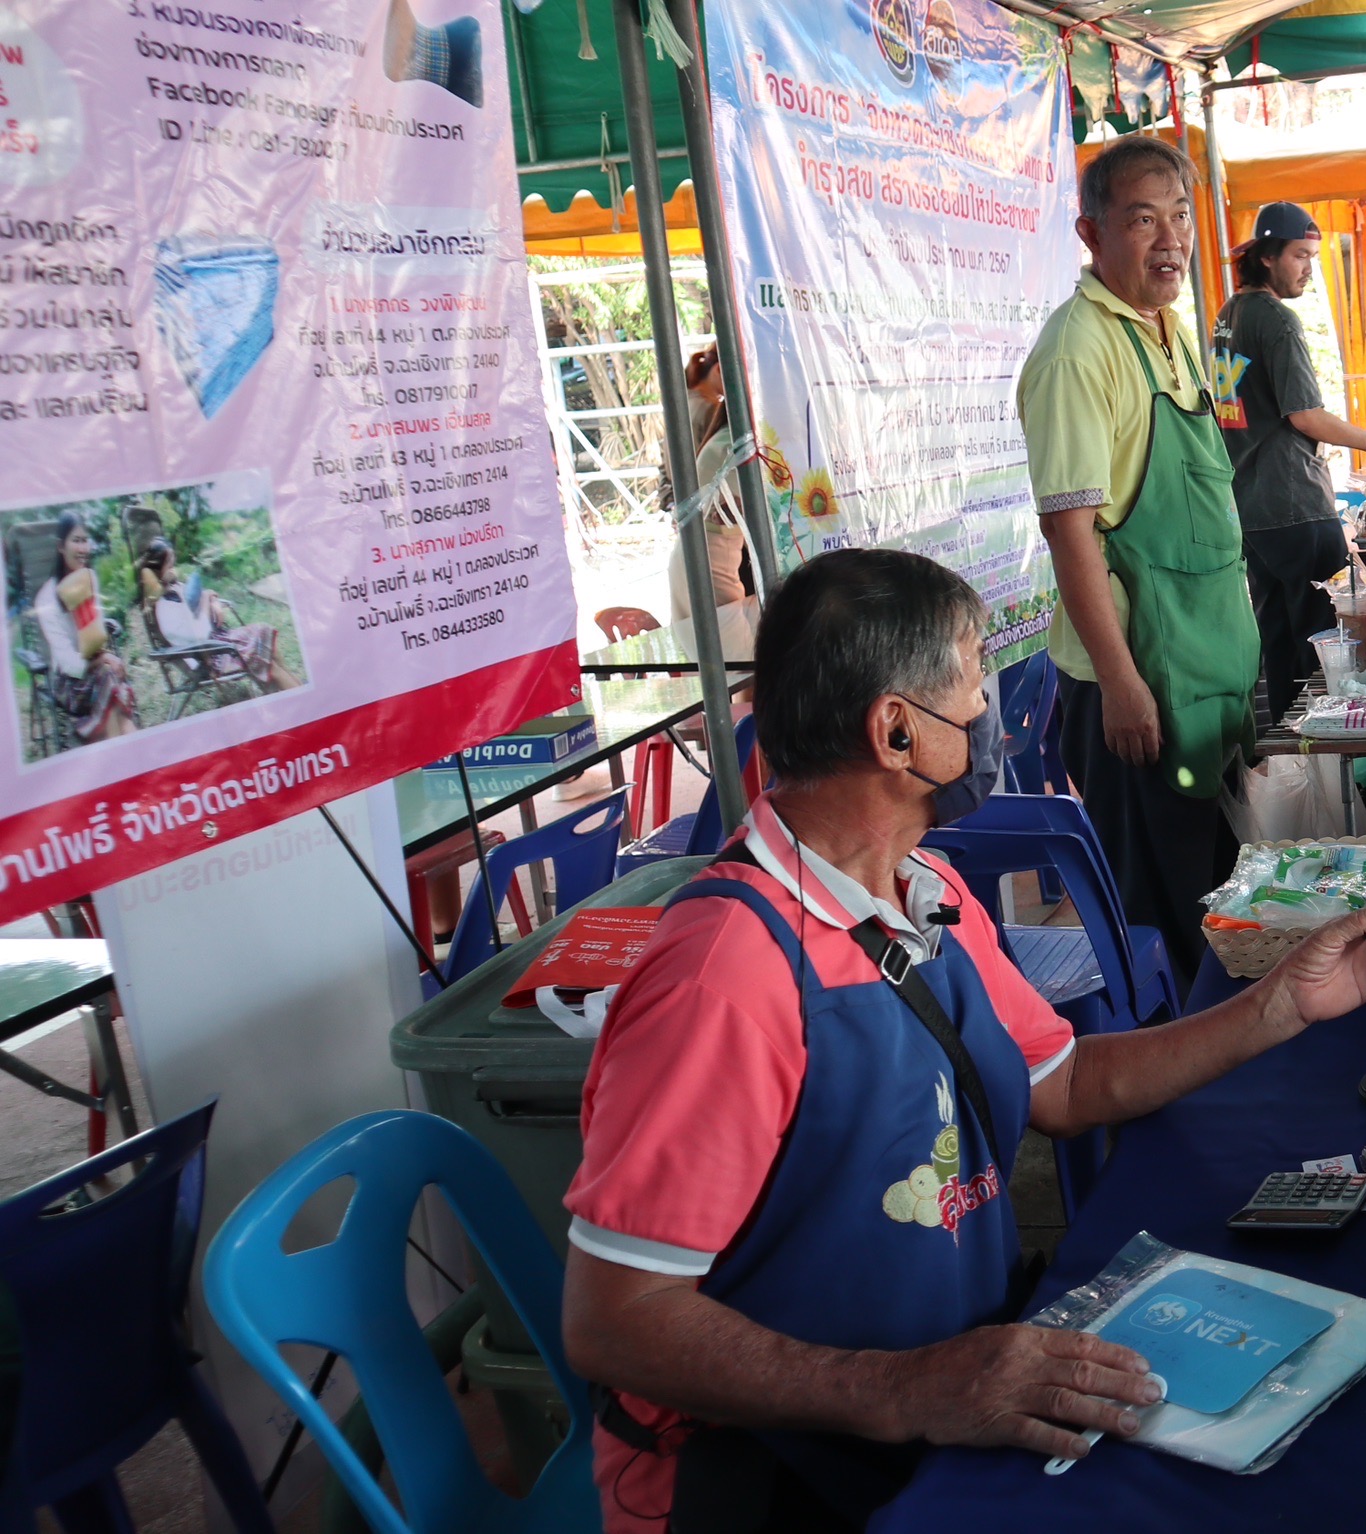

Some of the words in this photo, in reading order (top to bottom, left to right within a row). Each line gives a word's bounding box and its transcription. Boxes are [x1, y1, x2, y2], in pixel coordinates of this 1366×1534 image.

[134, 30, 306, 82] ช่องทางการตลาด
[146, 76, 259, 112] Facebook
[753, 53, 850, 124] โครงการ
[158, 118, 182, 142] ID
[988, 252, 1012, 276] 2567
[413, 441, 436, 468] หมู่
[411, 497, 491, 525] 0866443798
[371, 546, 387, 564] 3.
[339, 576, 369, 604] ที่อยู่
[372, 564, 408, 596] เลขที่
[432, 558, 454, 585] หมู่
[493, 573, 530, 597] 24140
[402, 629, 431, 651] โทร.
[432, 608, 505, 643] 0844333580
[122, 742, 351, 845] จังหวัดฉะเชิงเทรา
[1203, 1309, 1255, 1331] Krungthai
[1182, 1317, 1282, 1357] NEXT
